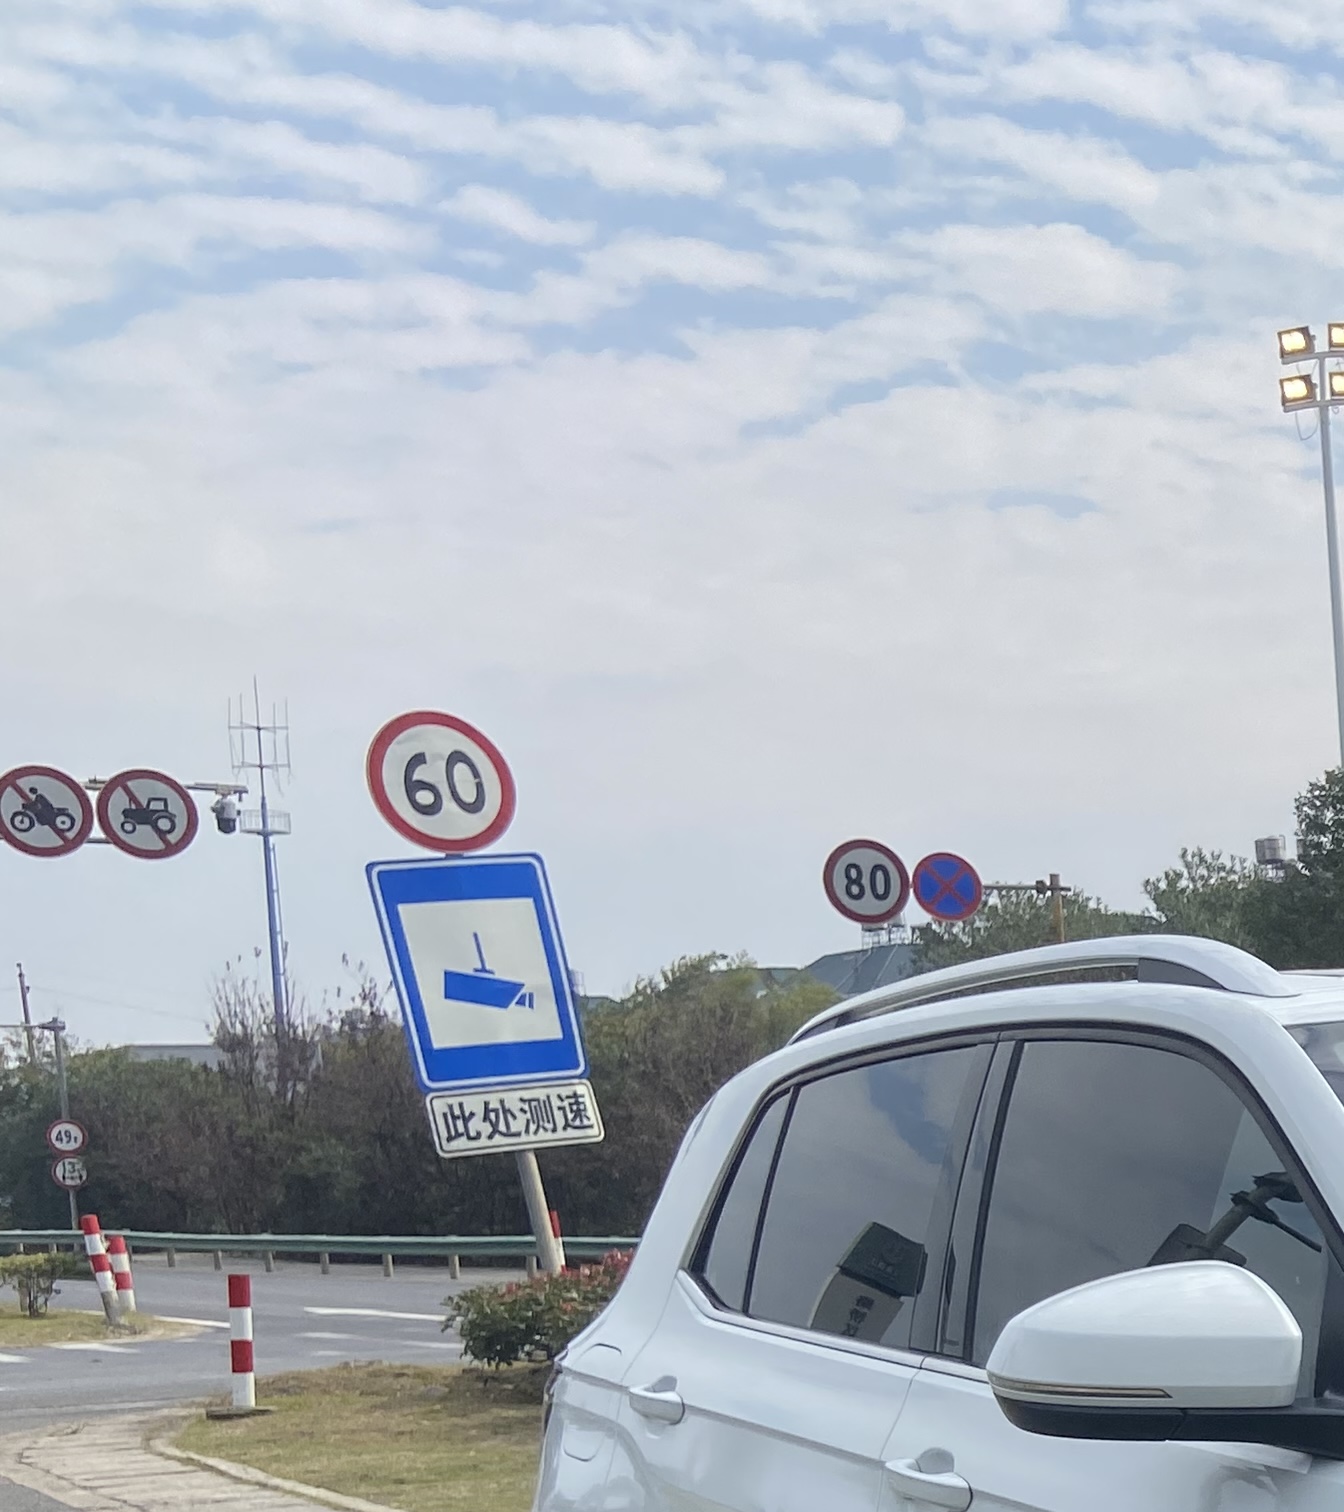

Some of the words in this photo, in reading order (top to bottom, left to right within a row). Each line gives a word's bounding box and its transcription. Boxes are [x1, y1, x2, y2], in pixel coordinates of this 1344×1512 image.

[404, 749, 486, 816] 60
[844, 863, 891, 901] 80
[441, 1089, 595, 1144] 此处测速
